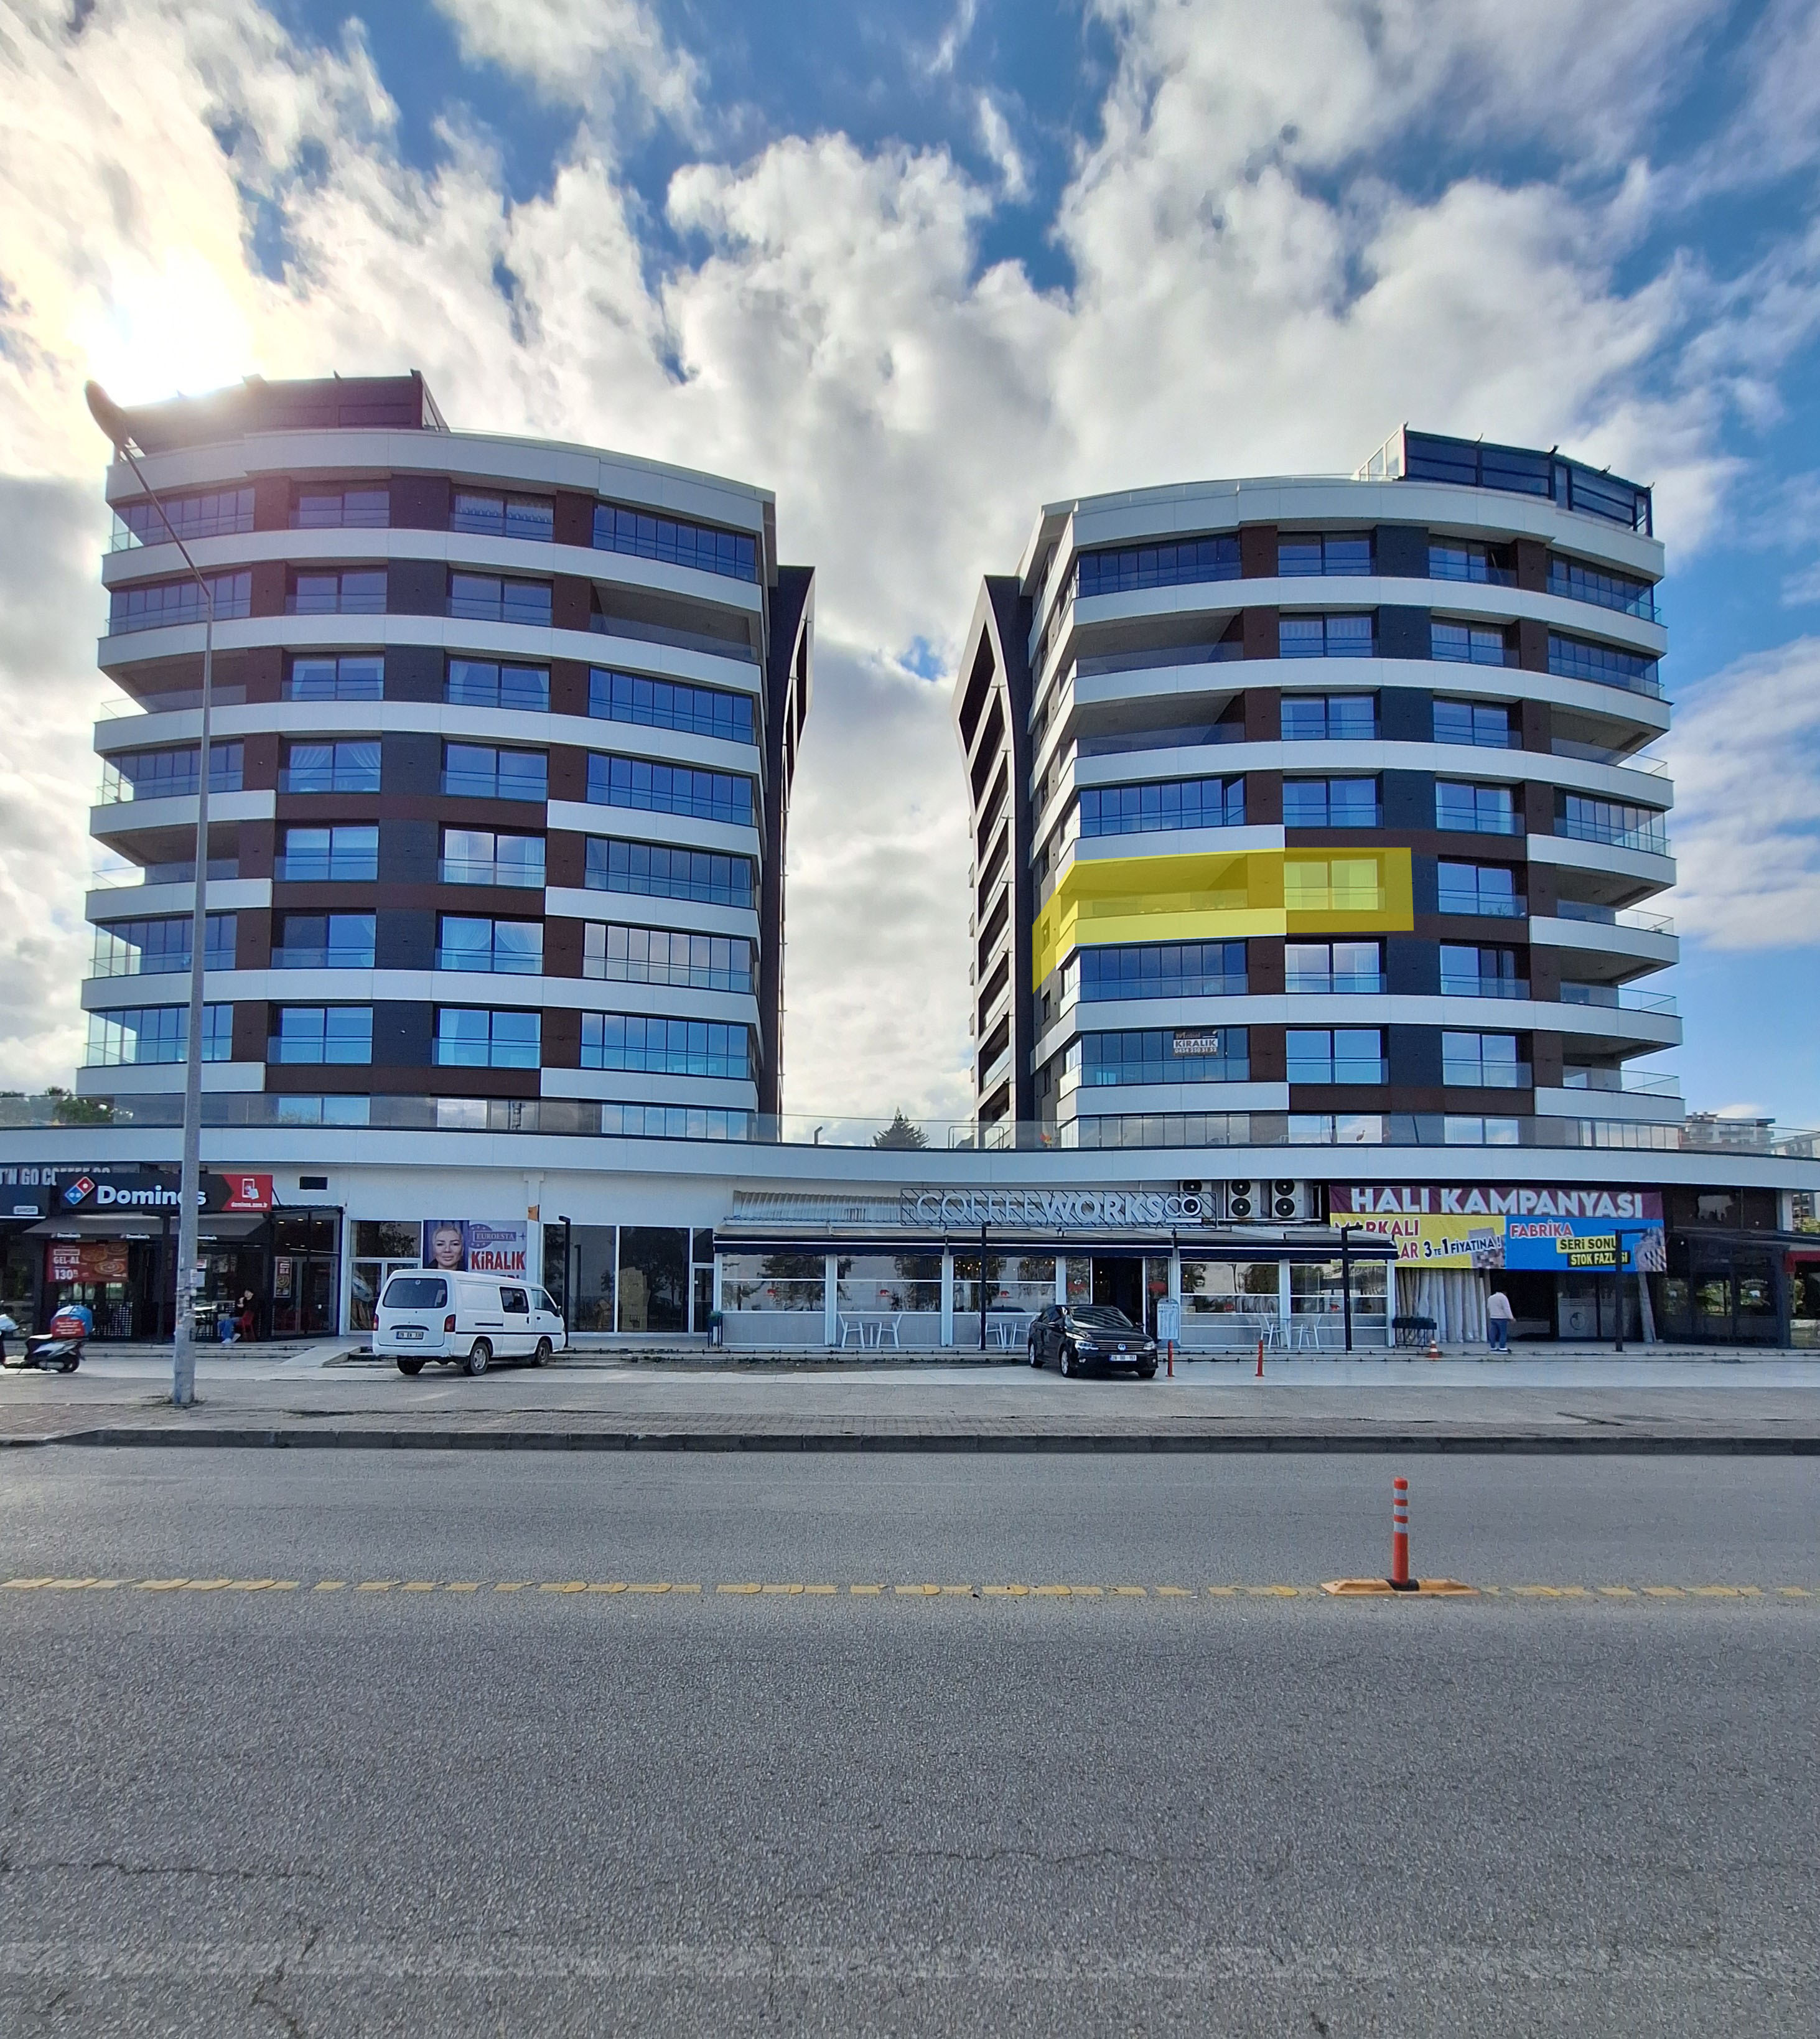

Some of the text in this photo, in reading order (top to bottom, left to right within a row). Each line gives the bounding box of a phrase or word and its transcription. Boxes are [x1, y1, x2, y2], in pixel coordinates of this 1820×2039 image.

[22, 1168, 40, 1185] GO
[1351, 1188, 1643, 1219] HALI KAMPANYASI
[476, 1233, 515, 1241] EUROESTA
[1334, 1220, 1419, 1237] RKALI
[1511, 1220, 1574, 1238] FABRİKA
[1423, 1241, 1432, 1257] 3
[1442, 1238, 1449, 1255] 1
[1570, 1251, 1628, 1266] STOK FAZLSI
